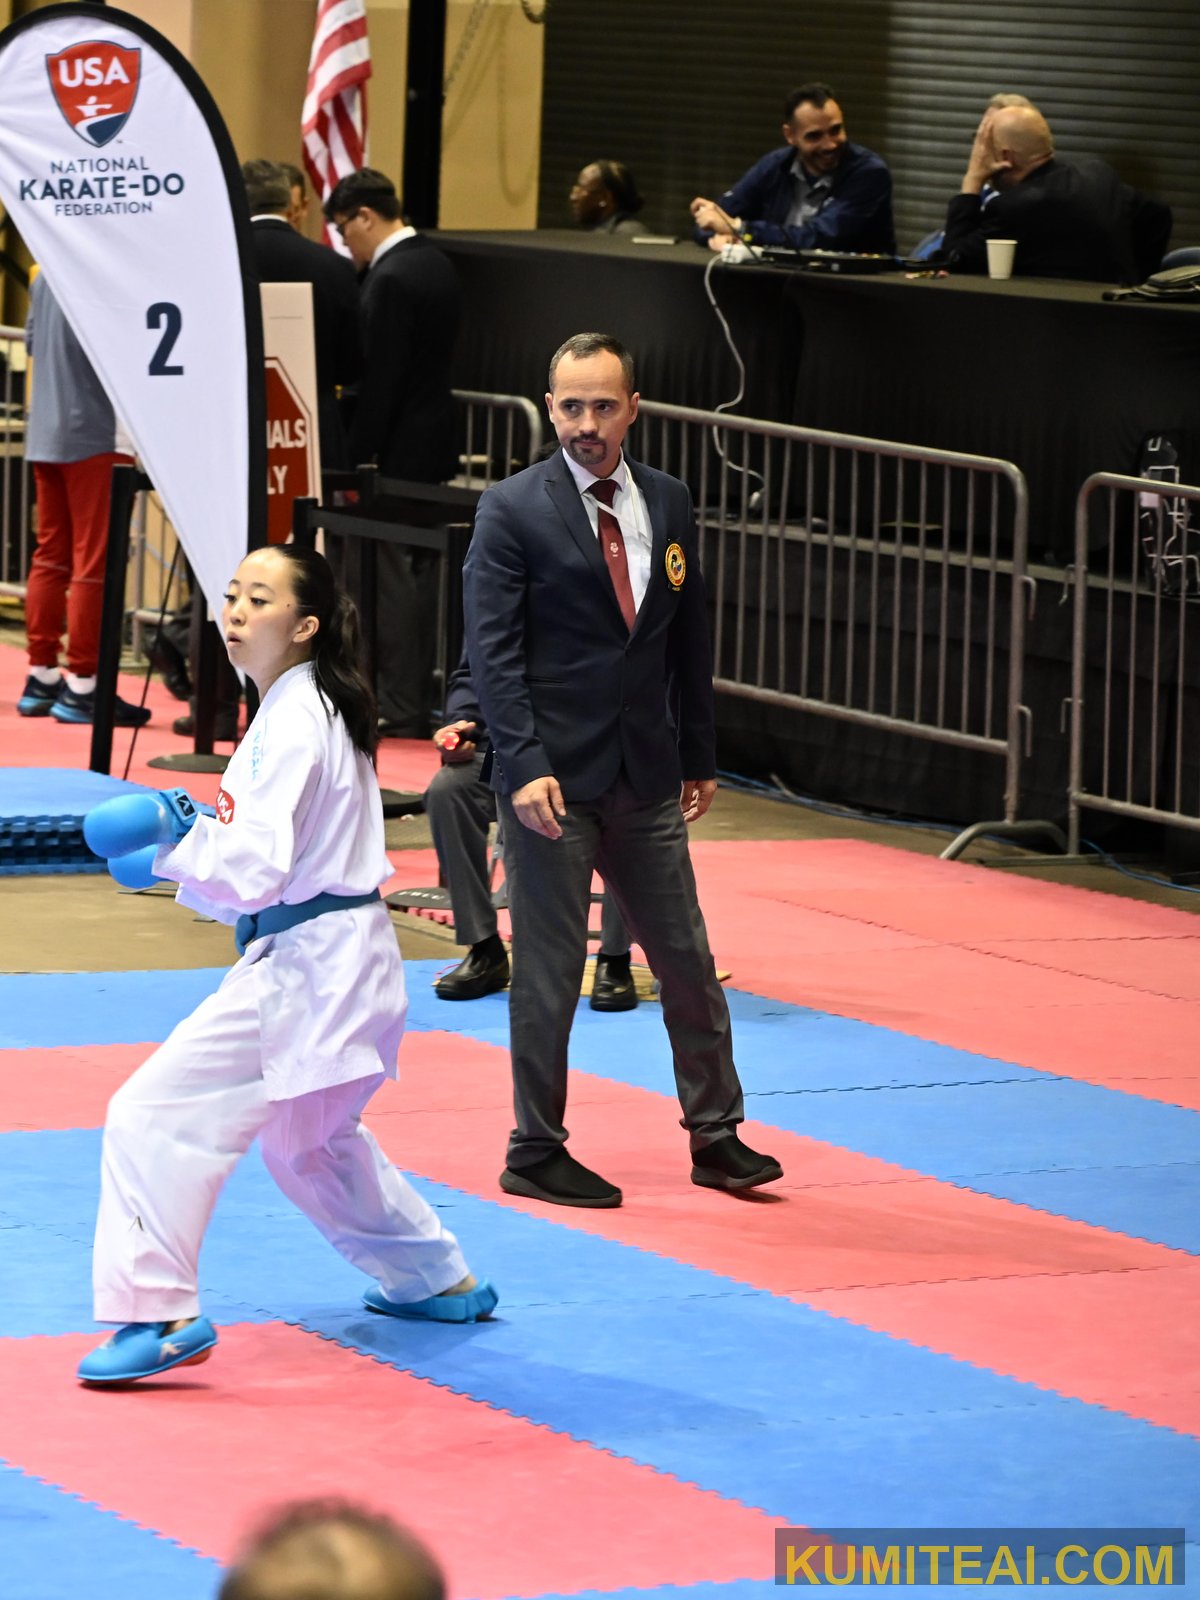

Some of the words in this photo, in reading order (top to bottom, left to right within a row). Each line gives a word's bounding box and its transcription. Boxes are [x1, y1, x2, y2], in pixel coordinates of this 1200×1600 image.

[58, 56, 130, 88] USA
[51, 156, 149, 174] NATIONAL
[20, 173, 184, 200] KARATE-DO
[55, 201, 152, 216] FEDERATION
[146, 301, 184, 376] 2
